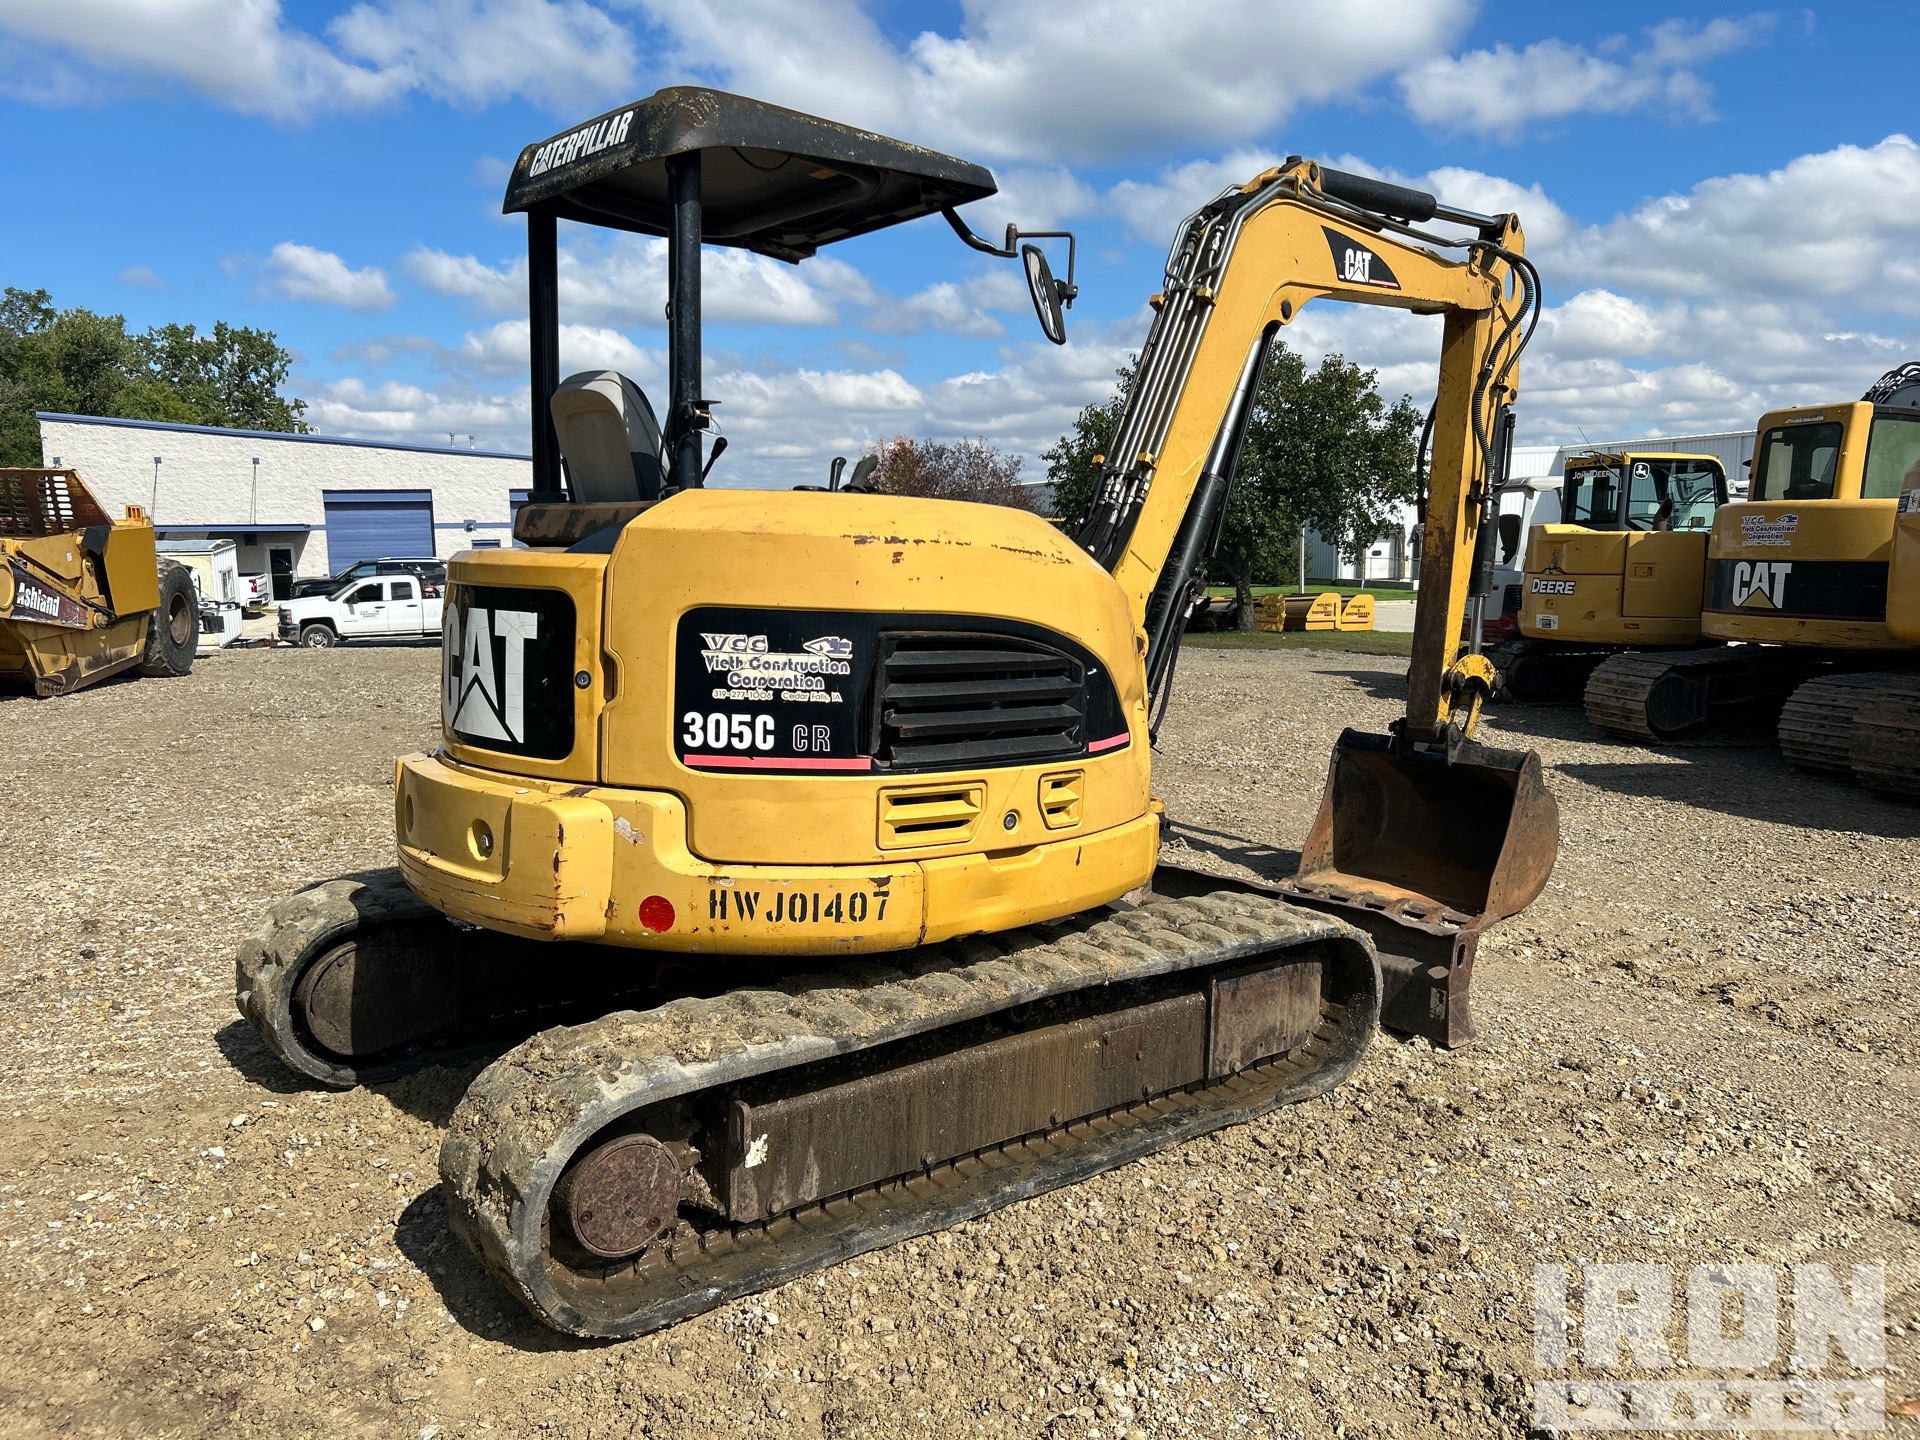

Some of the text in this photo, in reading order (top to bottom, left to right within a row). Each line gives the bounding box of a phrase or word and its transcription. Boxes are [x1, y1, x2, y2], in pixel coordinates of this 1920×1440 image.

[530, 111, 633, 177] CATERPILLAR
[1345, 248, 1372, 283] CAT
[16, 582, 60, 617] Ashland
[1531, 579, 1576, 595] DEERE
[1732, 561, 1793, 609] CAT
[702, 634, 768, 652] VCC
[442, 603, 538, 744] CAT
[704, 654, 850, 675] Vieth Construction
[728, 672, 825, 690] Corporation
[713, 689, 773, 700] 319-277-1006
[782, 692, 809, 700] Cedar
[832, 692, 843, 702] IA
[683, 711, 831, 752] 305C CR
